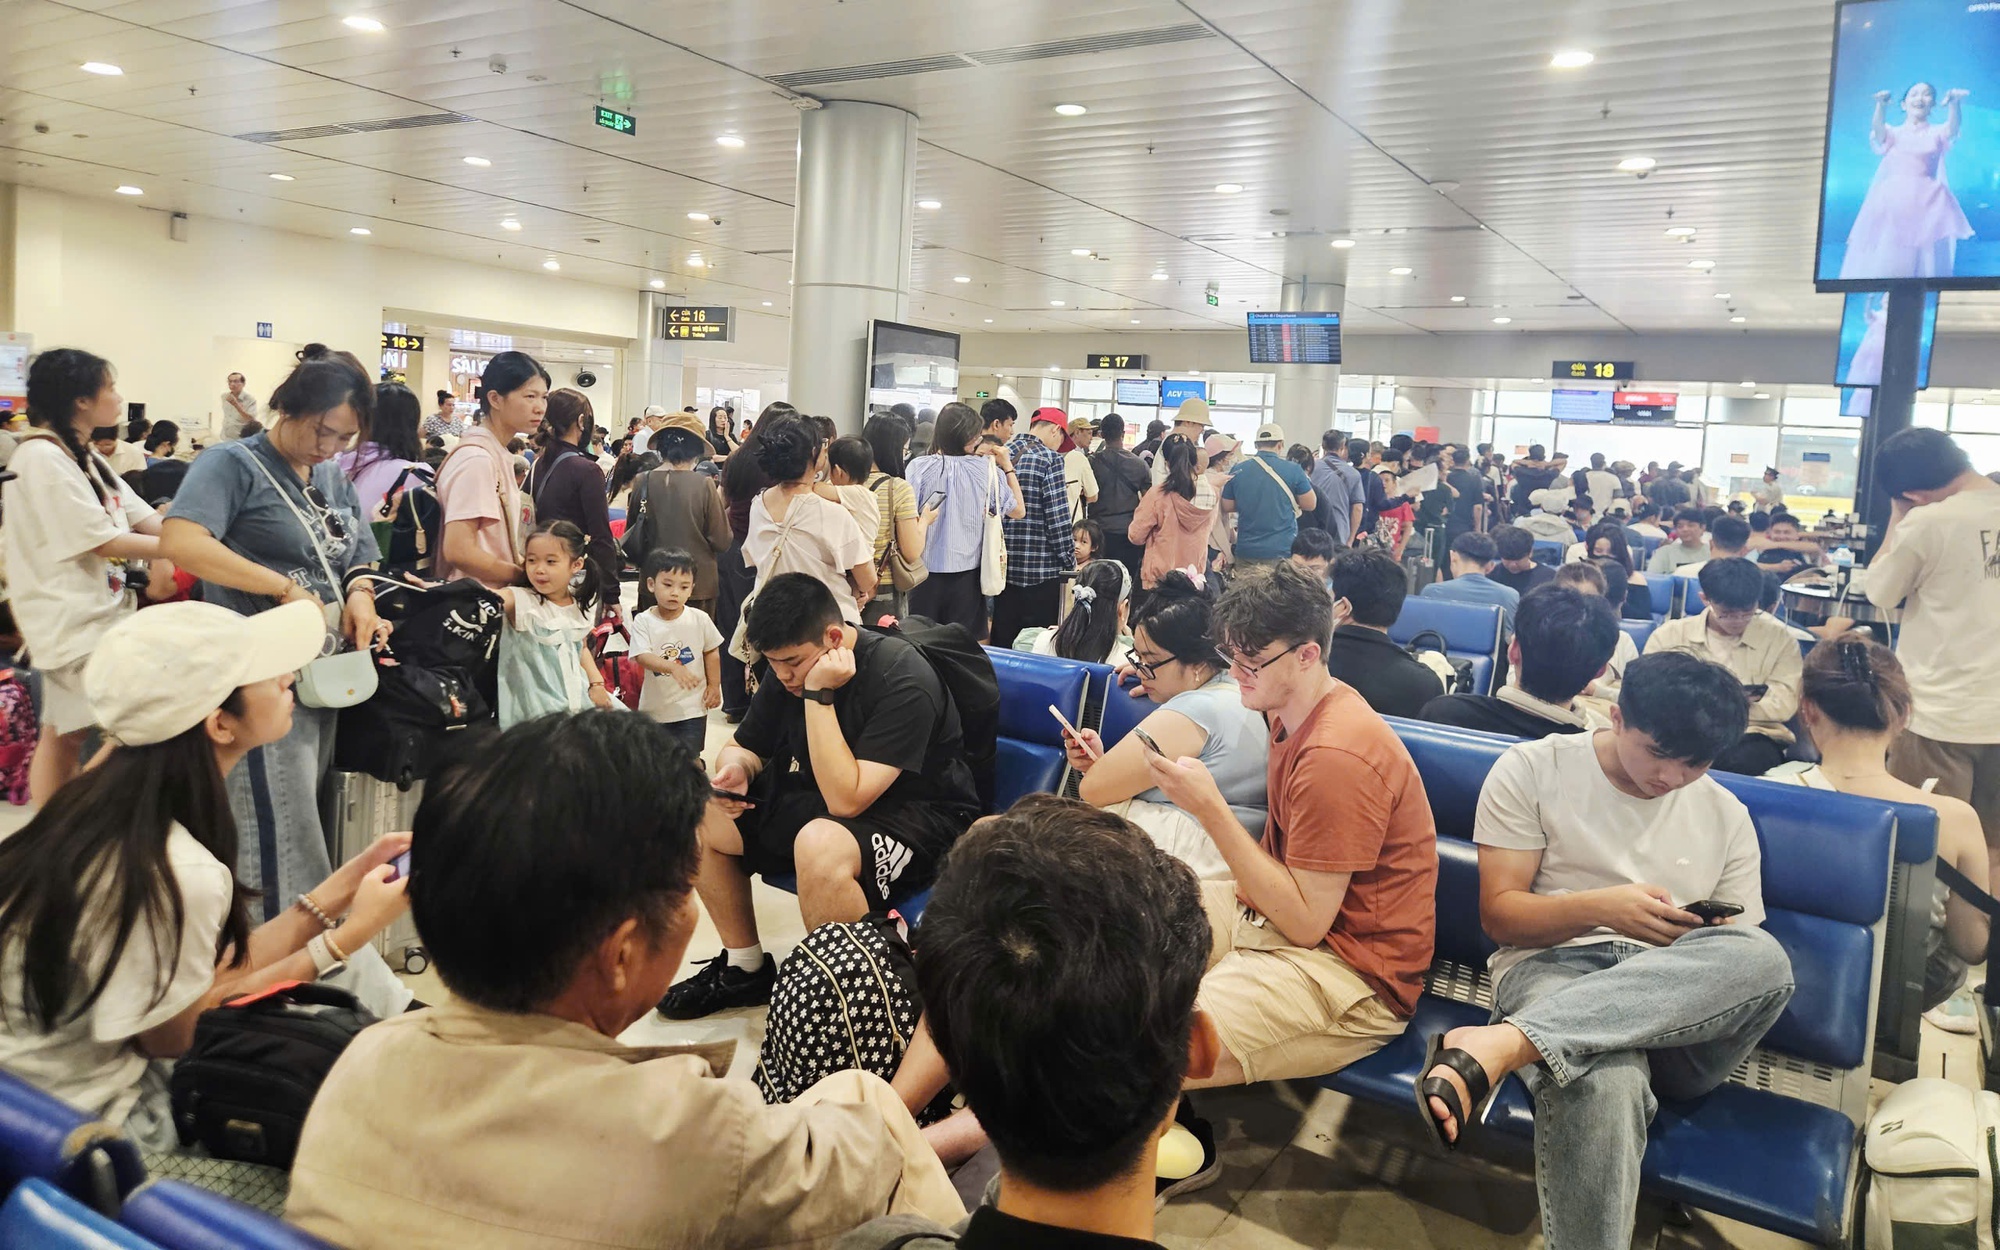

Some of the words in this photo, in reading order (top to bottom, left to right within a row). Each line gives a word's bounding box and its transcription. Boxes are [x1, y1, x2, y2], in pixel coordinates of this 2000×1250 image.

[693, 309, 706, 323] 16
[392, 336, 408, 349] 16
[1115, 356, 1129, 368] 17
[1593, 363, 1615, 378] 18
[871, 832, 892, 900] adidas
